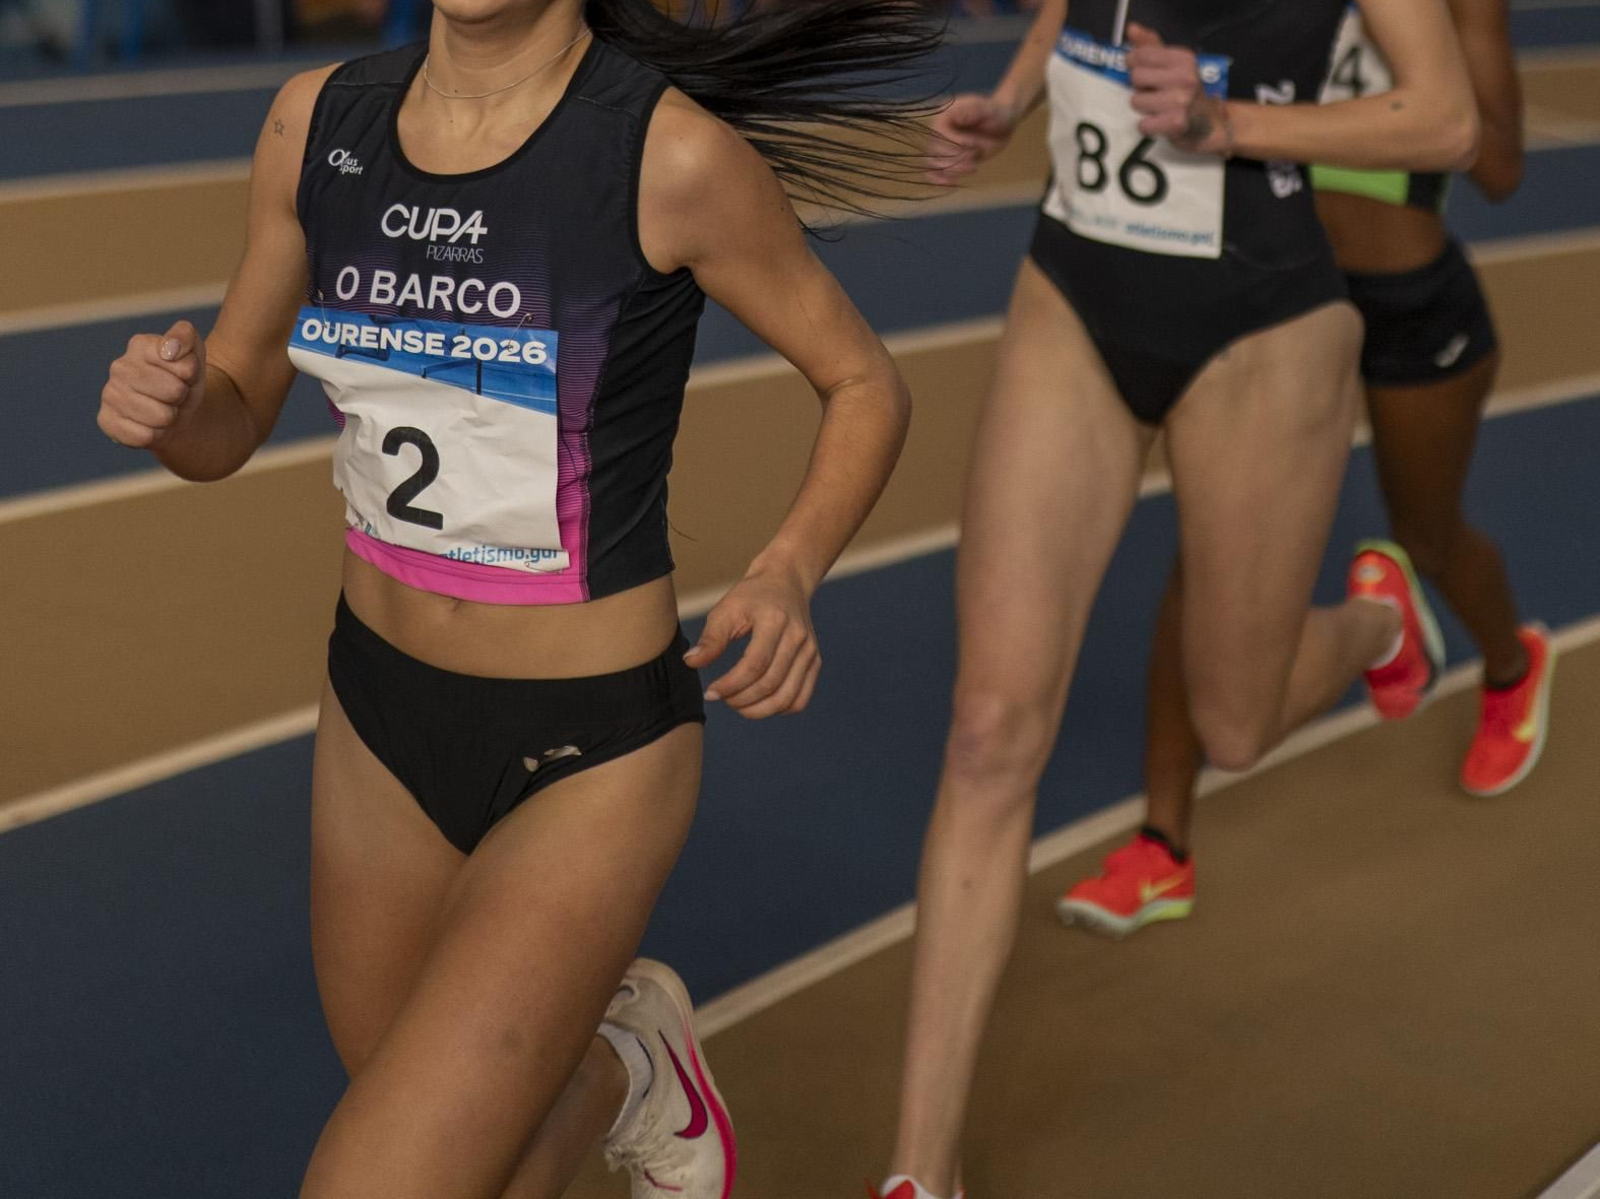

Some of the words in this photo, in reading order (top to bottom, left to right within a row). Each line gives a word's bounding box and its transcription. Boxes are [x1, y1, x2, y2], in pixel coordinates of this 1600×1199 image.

[1075, 121, 1169, 206] 86
[381, 203, 488, 245] CUPA
[426, 245, 484, 264] PIZARRAS
[336, 266, 360, 300] O
[369, 270, 521, 319] BARCO
[301, 318, 446, 356] OURENSE
[450, 334, 548, 365] 2026
[381, 426, 444, 531] 2
